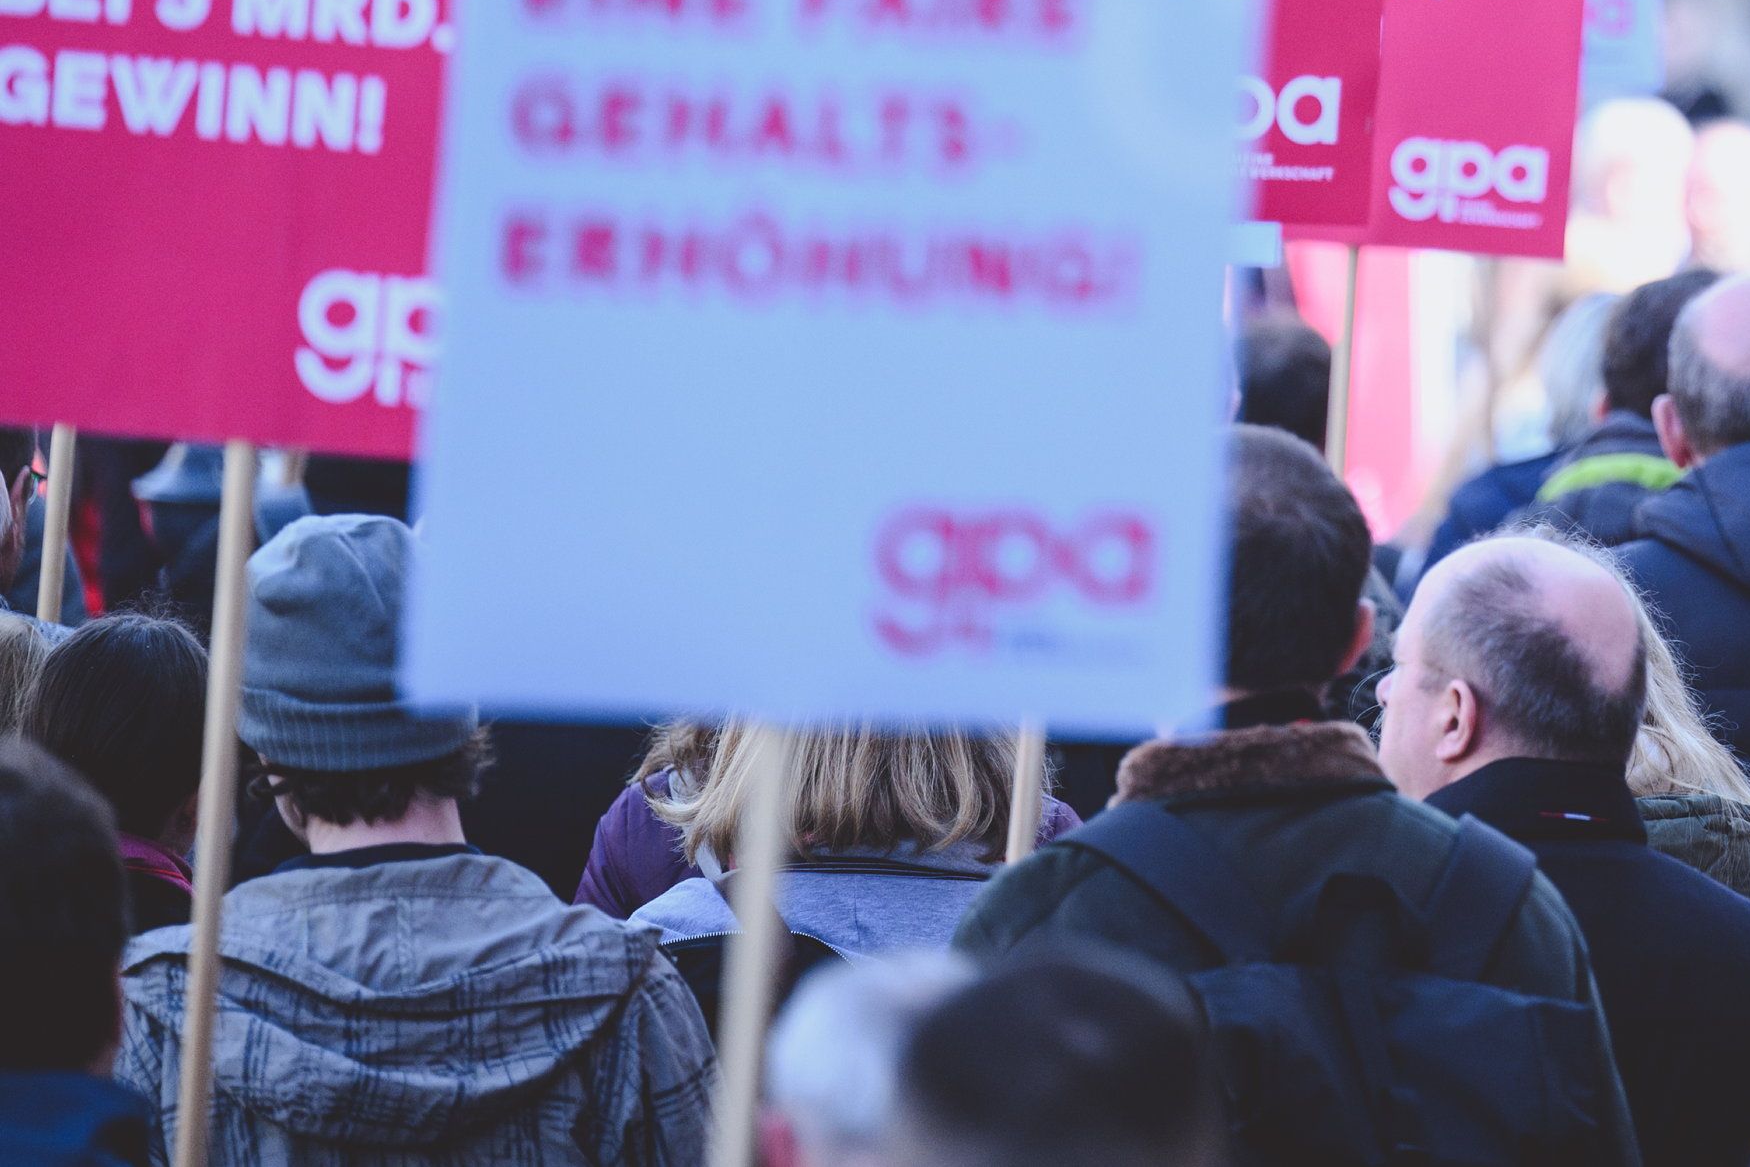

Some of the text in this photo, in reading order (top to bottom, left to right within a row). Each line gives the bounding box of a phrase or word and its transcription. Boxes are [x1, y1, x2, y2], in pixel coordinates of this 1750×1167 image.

[0, 45, 387, 155] GEWINN!
[1388, 136, 1550, 223] gpa
[872, 500, 1162, 661] gpa
